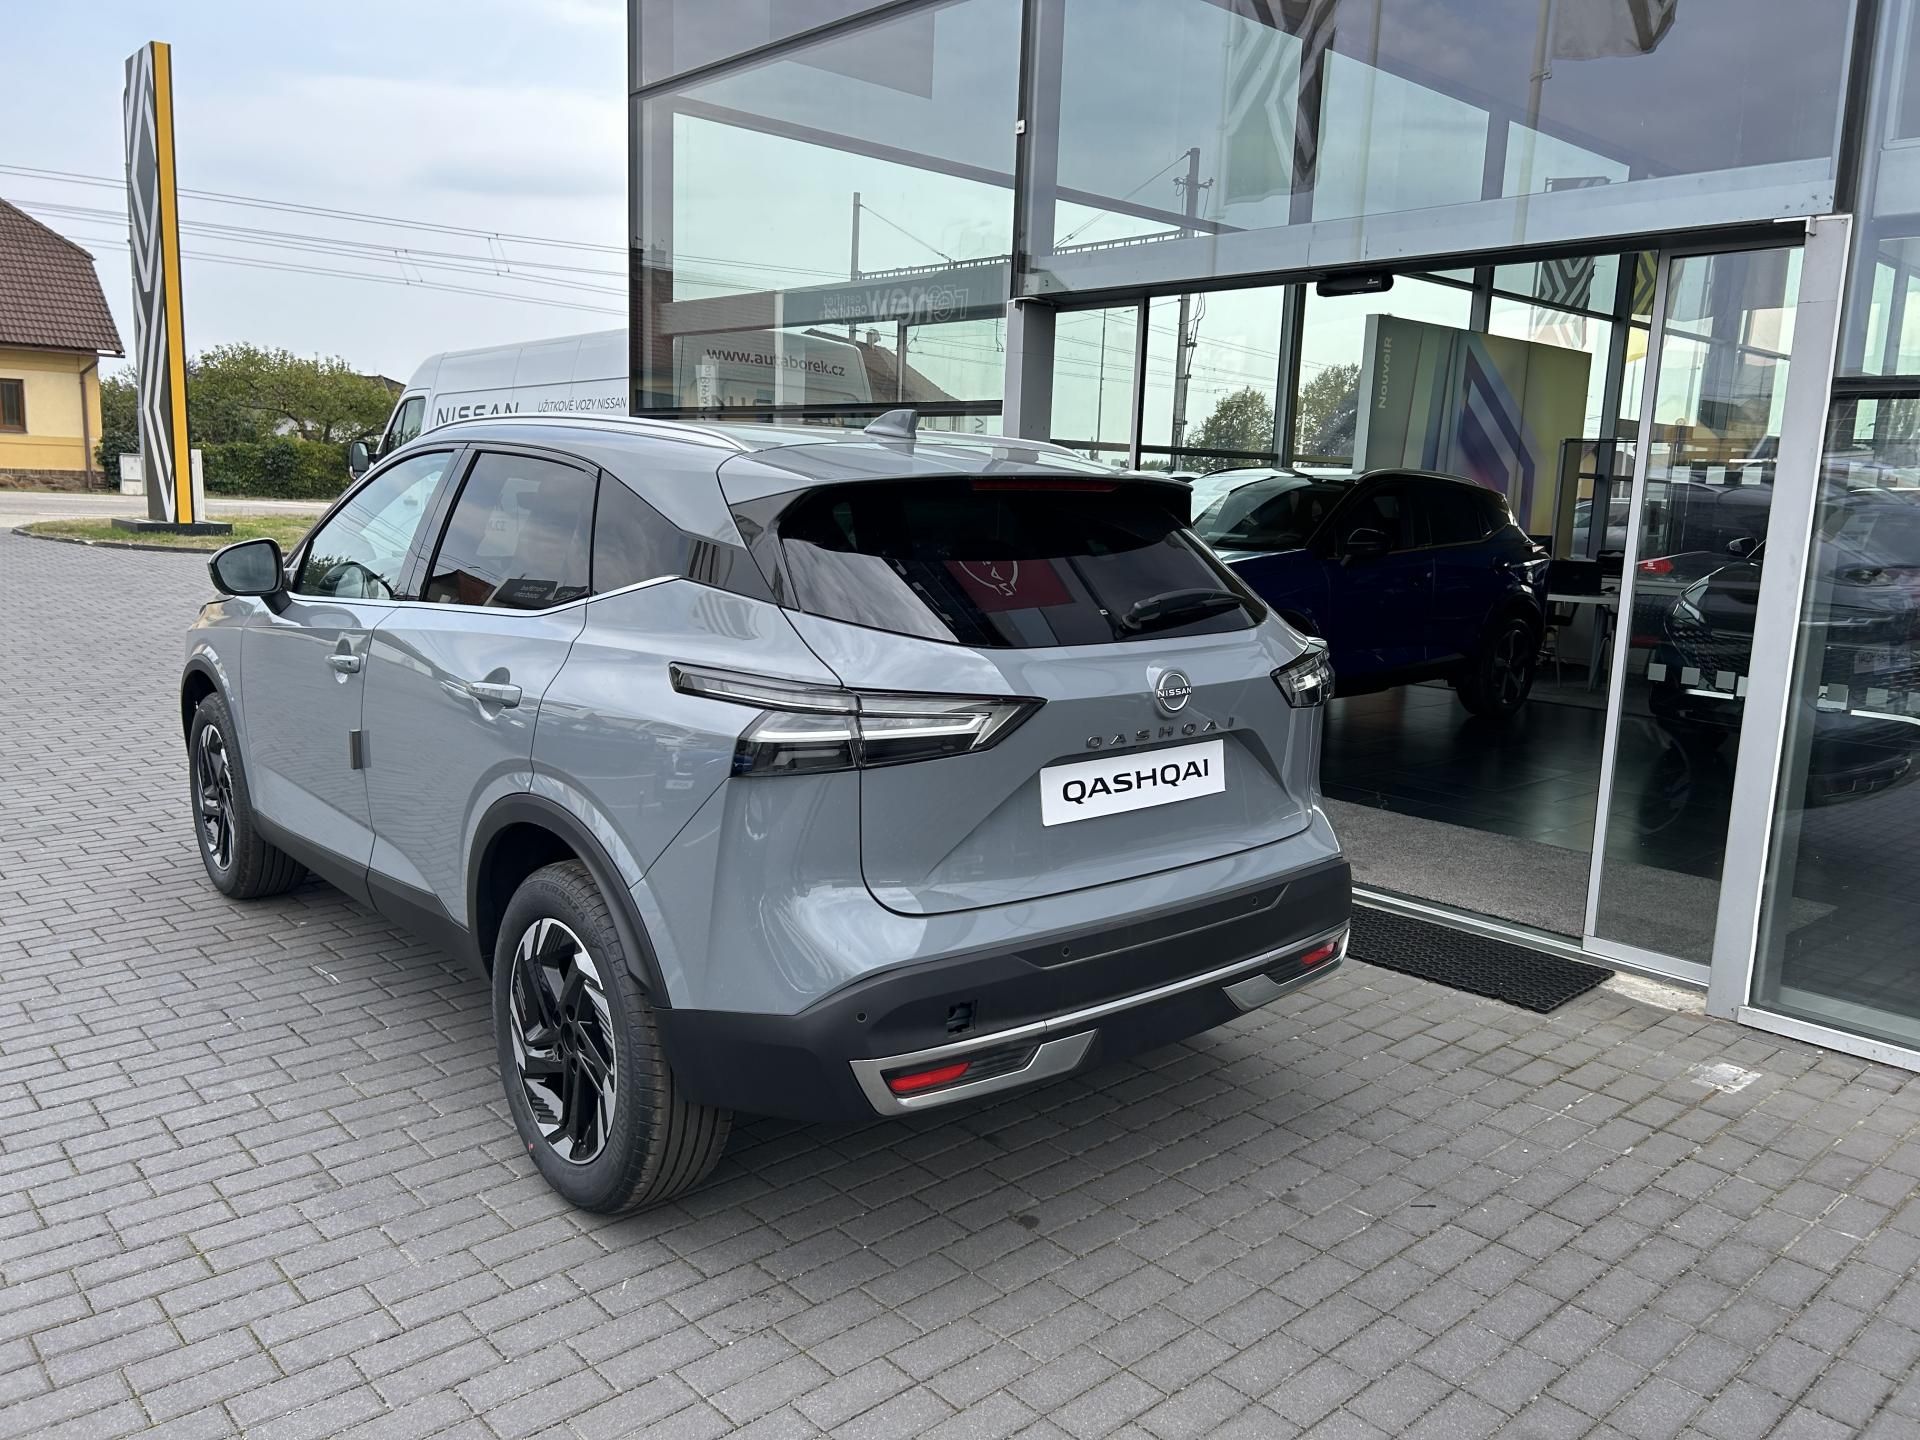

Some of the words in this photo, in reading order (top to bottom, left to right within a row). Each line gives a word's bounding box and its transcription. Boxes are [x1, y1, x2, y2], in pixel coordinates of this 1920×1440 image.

[436, 402, 519, 426] NISSAN
[537, 397, 574, 413] UŽITKOVÉ
[575, 398, 597, 411] VOZY
[597, 396, 627, 410] NISSAN
[1157, 686, 1192, 698] NISSAN
[1086, 716, 1235, 749] QASHQAI
[1062, 758, 1209, 805] QASHQAI
[540, 883, 586, 922] TURANZA
